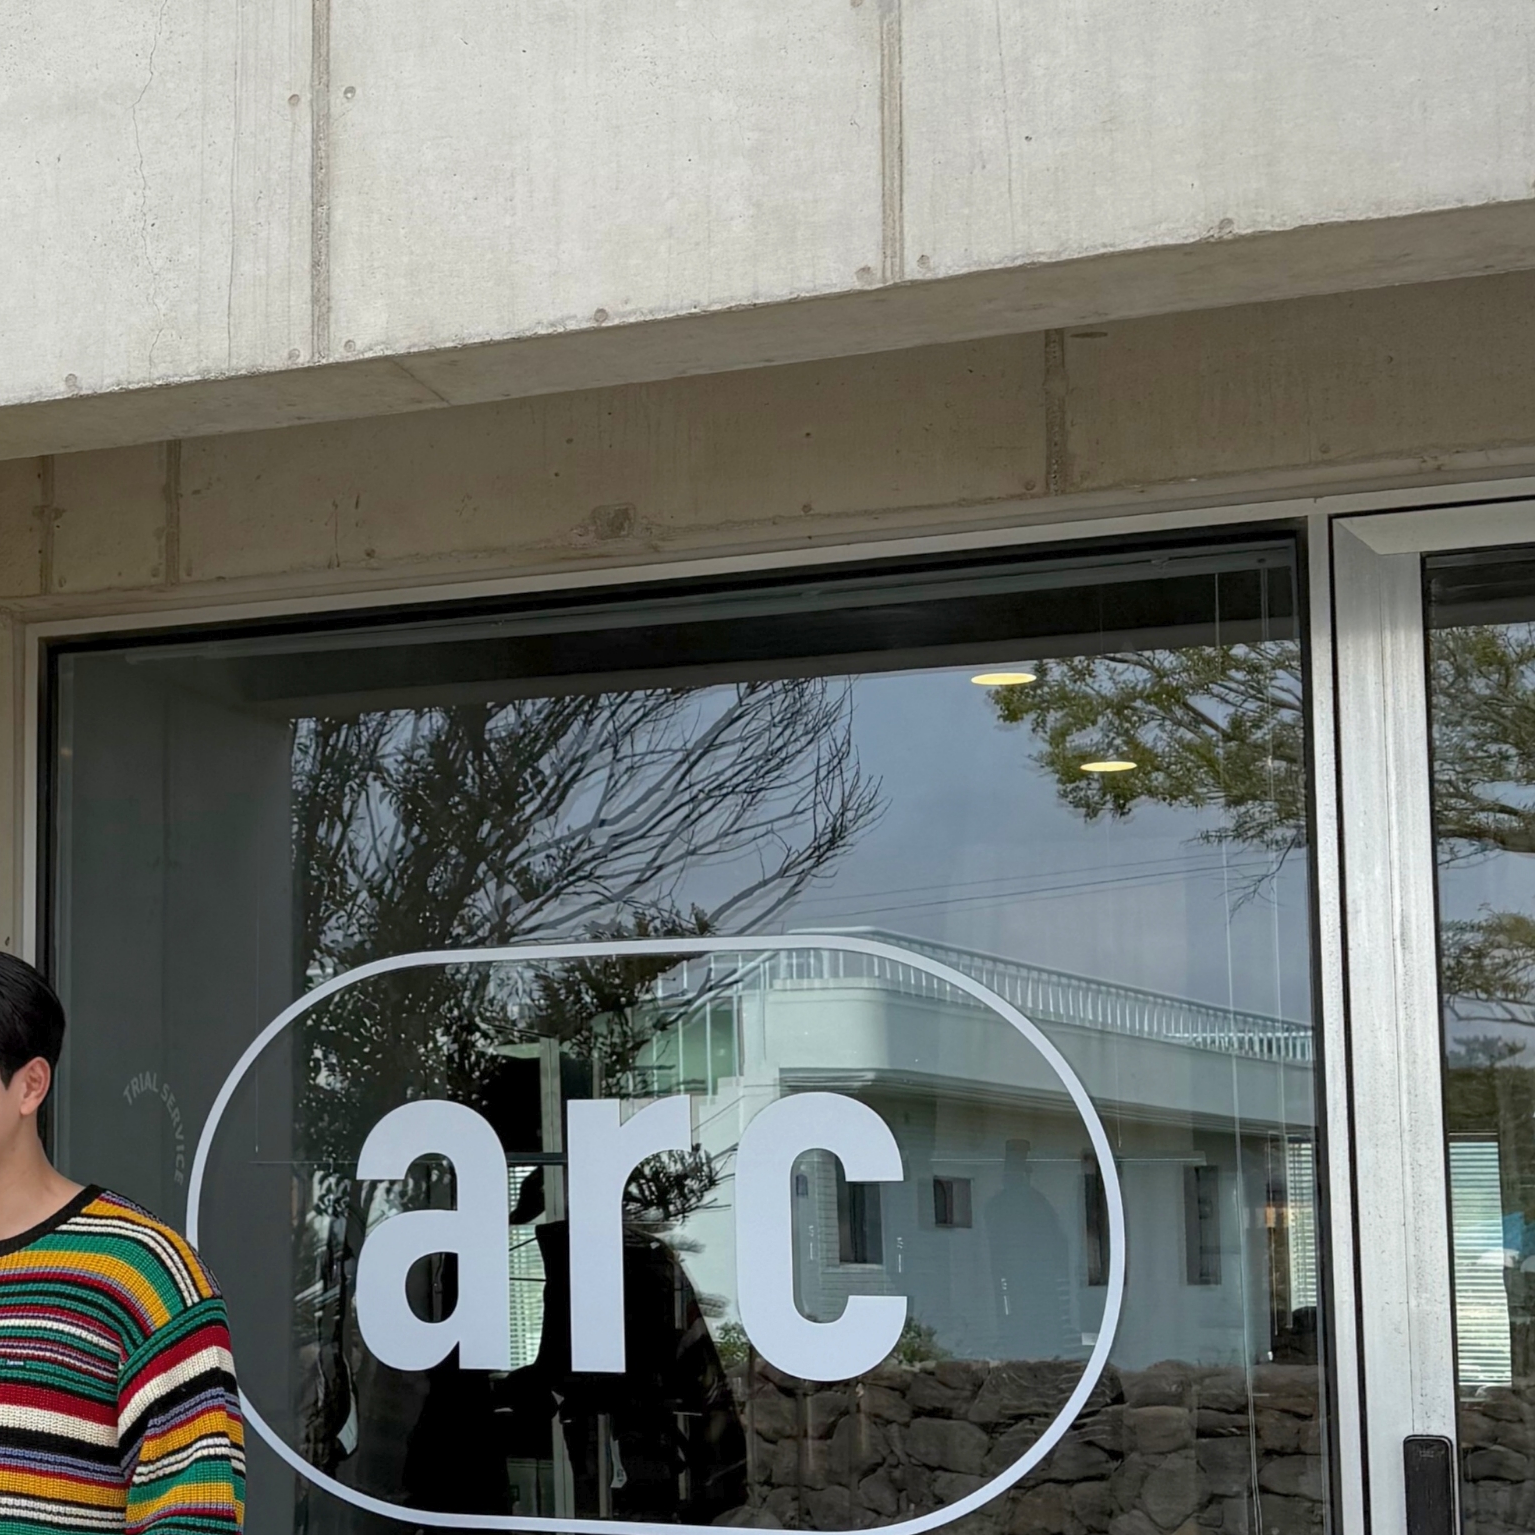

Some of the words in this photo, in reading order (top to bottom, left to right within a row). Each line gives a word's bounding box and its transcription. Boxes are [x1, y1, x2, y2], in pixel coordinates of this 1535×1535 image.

[122, 1070, 159, 1106] TRIAL
[160, 1083, 185, 1186] SERVICE
[356, 1092, 907, 1382] arc
